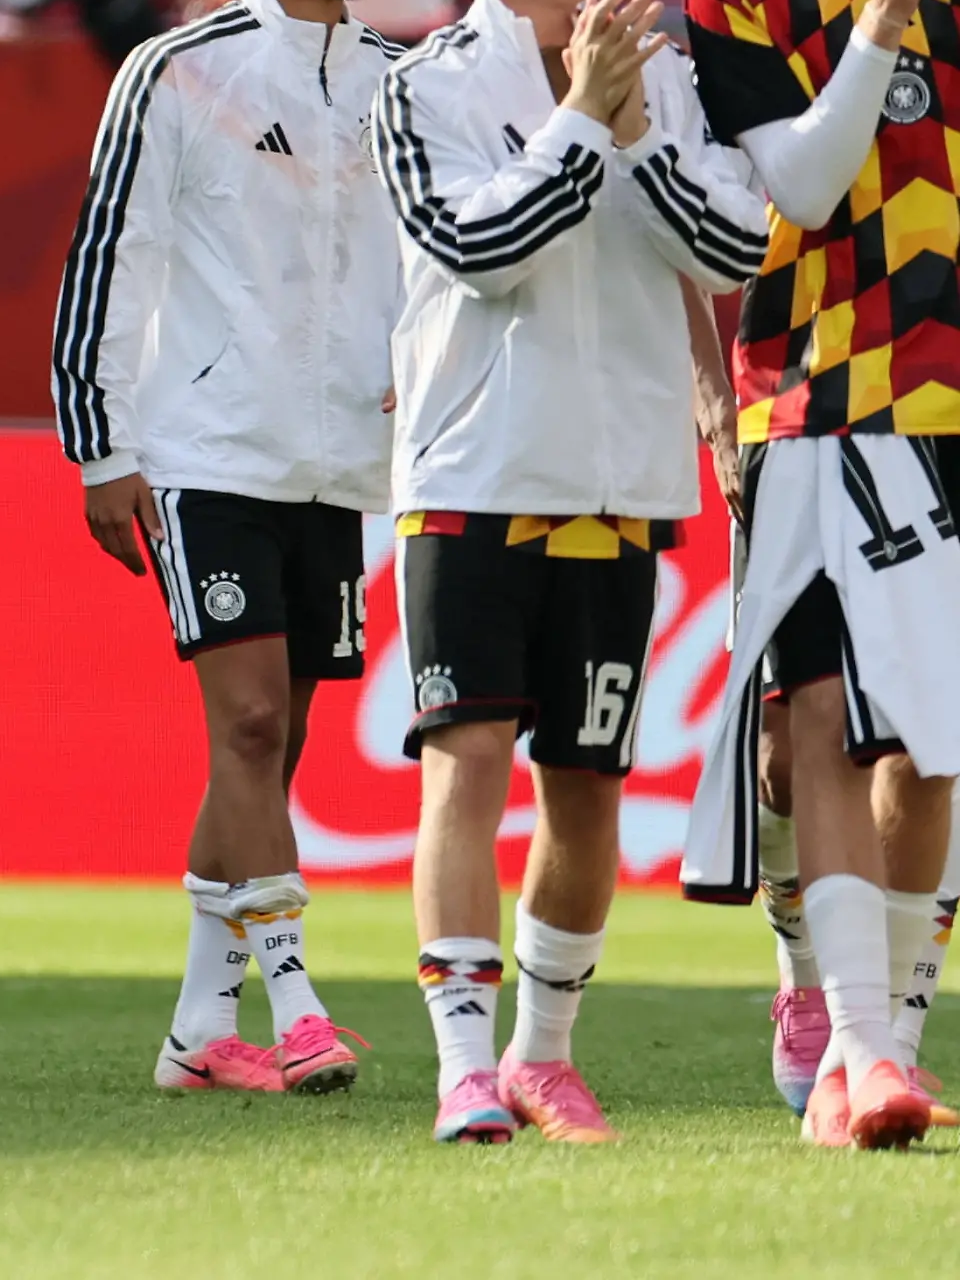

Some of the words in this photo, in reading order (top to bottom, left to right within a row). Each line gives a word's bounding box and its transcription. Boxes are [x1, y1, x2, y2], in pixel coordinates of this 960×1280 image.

[577, 660, 634, 746] 16
[265, 933, 299, 951] DFB
[912, 962, 937, 979] FB
